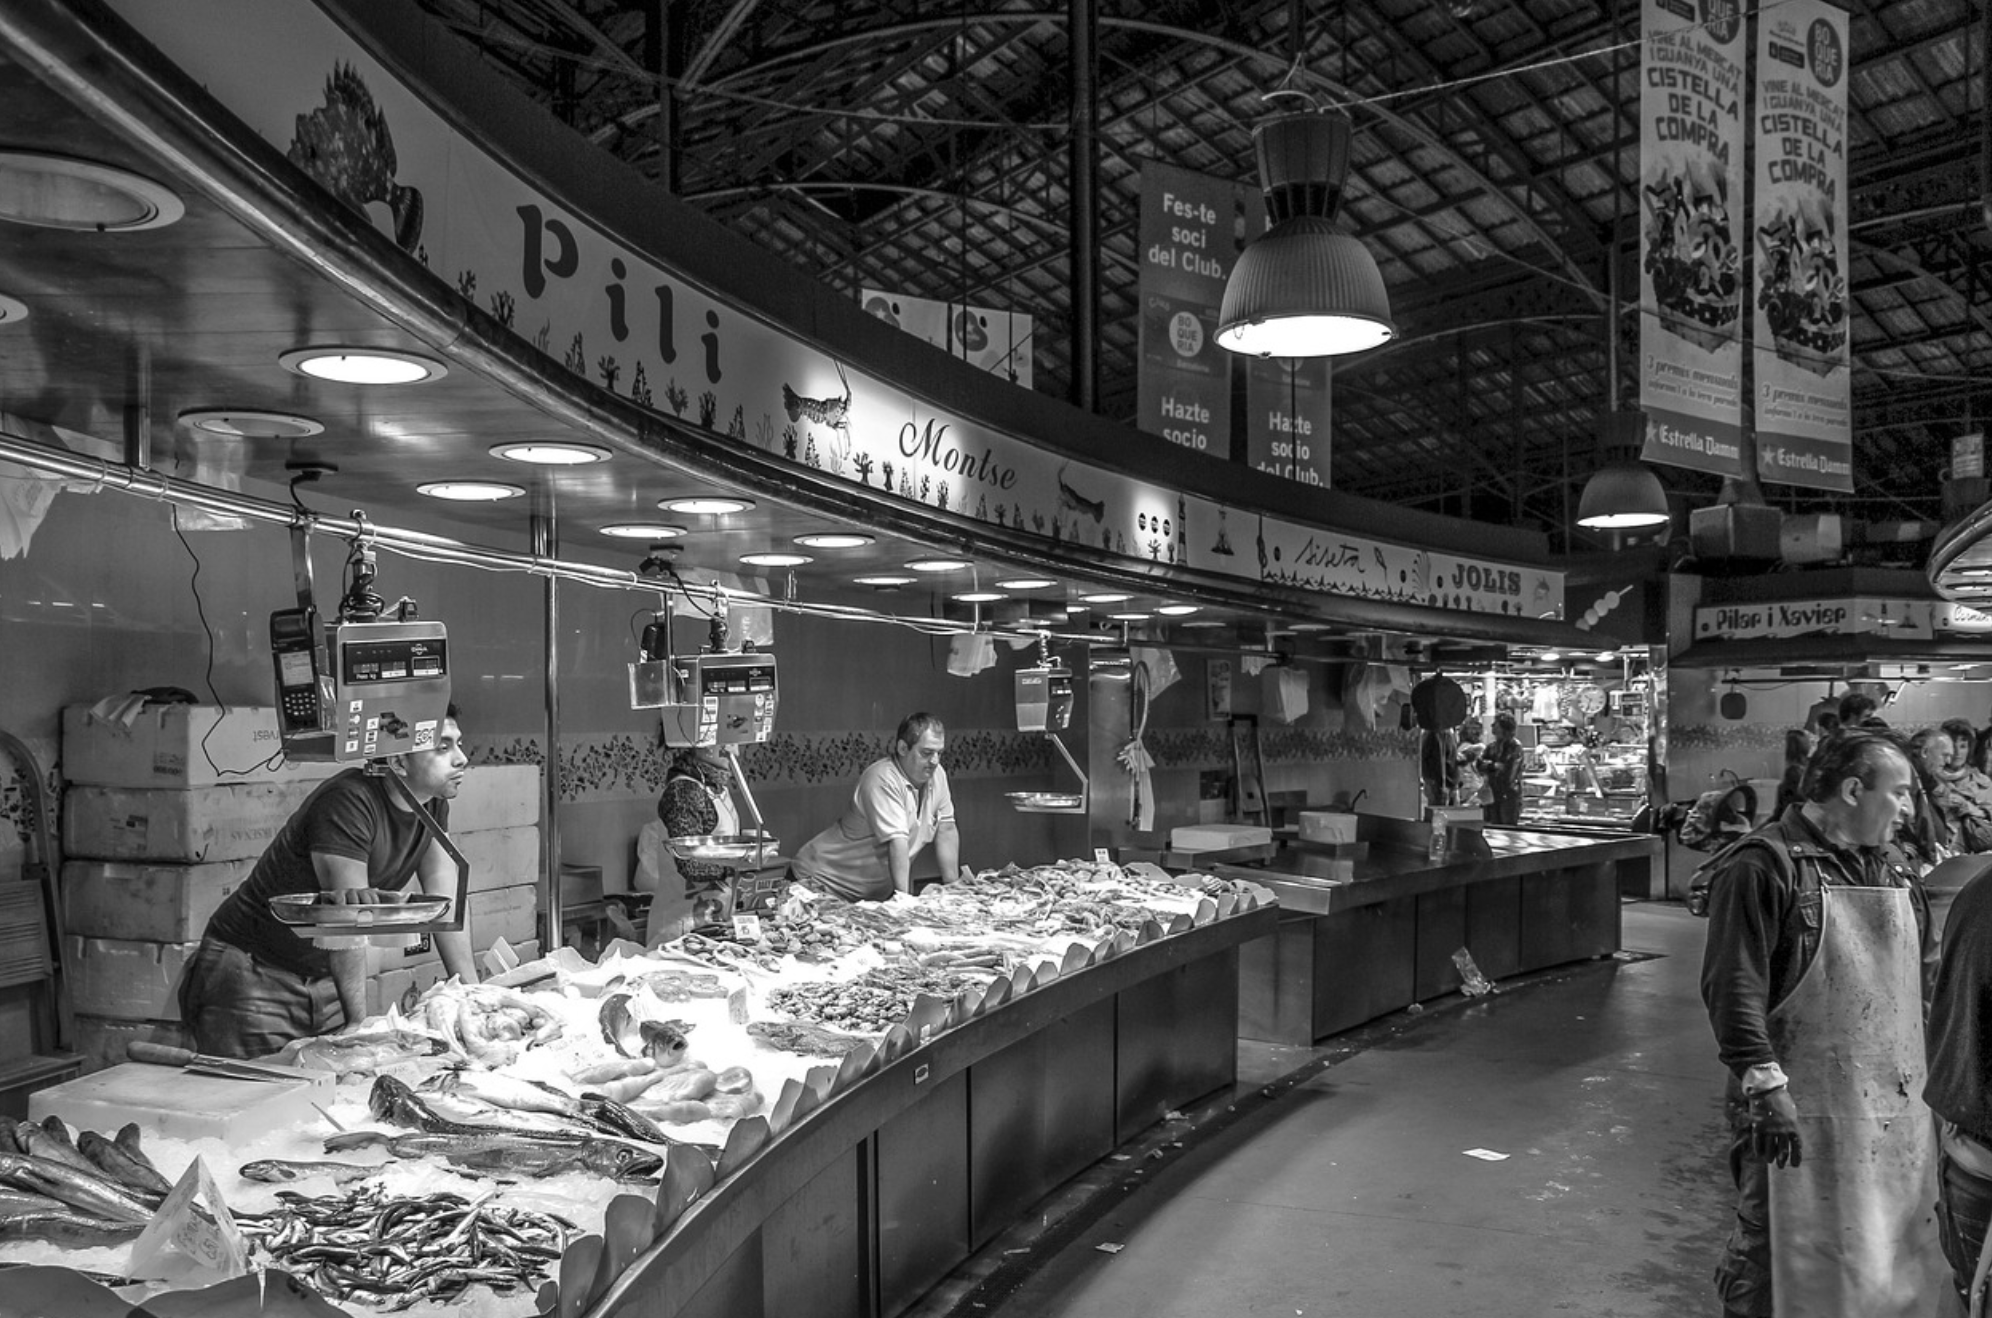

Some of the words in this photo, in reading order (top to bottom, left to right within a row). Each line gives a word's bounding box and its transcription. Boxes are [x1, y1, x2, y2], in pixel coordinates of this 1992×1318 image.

[1679, 34, 1695, 53] AL
[1815, 23, 1830, 45] BO
[1815, 42, 1838, 67] QUE
[1656, 47, 1707, 75] GUANYA
[1712, 66, 1738, 97] UNA
[1815, 61, 1834, 83] RIA
[1647, 67, 1739, 121] CISTELLA
[1668, 93, 1692, 116] DE
[1697, 100, 1718, 130] LA
[1655, 116, 1729, 166] COMPRA
[1761, 114, 1843, 160] CISTELLA
[1782, 137, 1803, 157] DE
[1807, 142, 1826, 169] LA
[1768, 159, 1835, 203] COMPRA
[1163, 192, 1217, 225] Fes-te
[1171, 226, 1206, 249] soci
[1148, 244, 1176, 268] del
[1181, 251, 1227, 280] Club.
[516, 204, 722, 384] pili
[1176, 328, 1198, 343] QUE
[1177, 315, 1192, 328] BO
[1176, 339, 1195, 354] RIA
[1161, 396, 1210, 424] Hazte
[898, 418, 1018, 490] Montse
[1163, 428, 1207, 450] socio
[1271, 440, 1310, 460] socio
[1659, 424, 1704, 452] Estrella
[1704, 435, 1739, 460] Damm
[1777, 448, 1818, 470] Estrella
[1819, 455, 1851, 475] Damm
[1452, 563, 1521, 596] JOLIS
[1716, 608, 1761, 630] Pilar
[1767, 606, 1774, 627] i
[1778, 603, 1846, 626] Xavier
